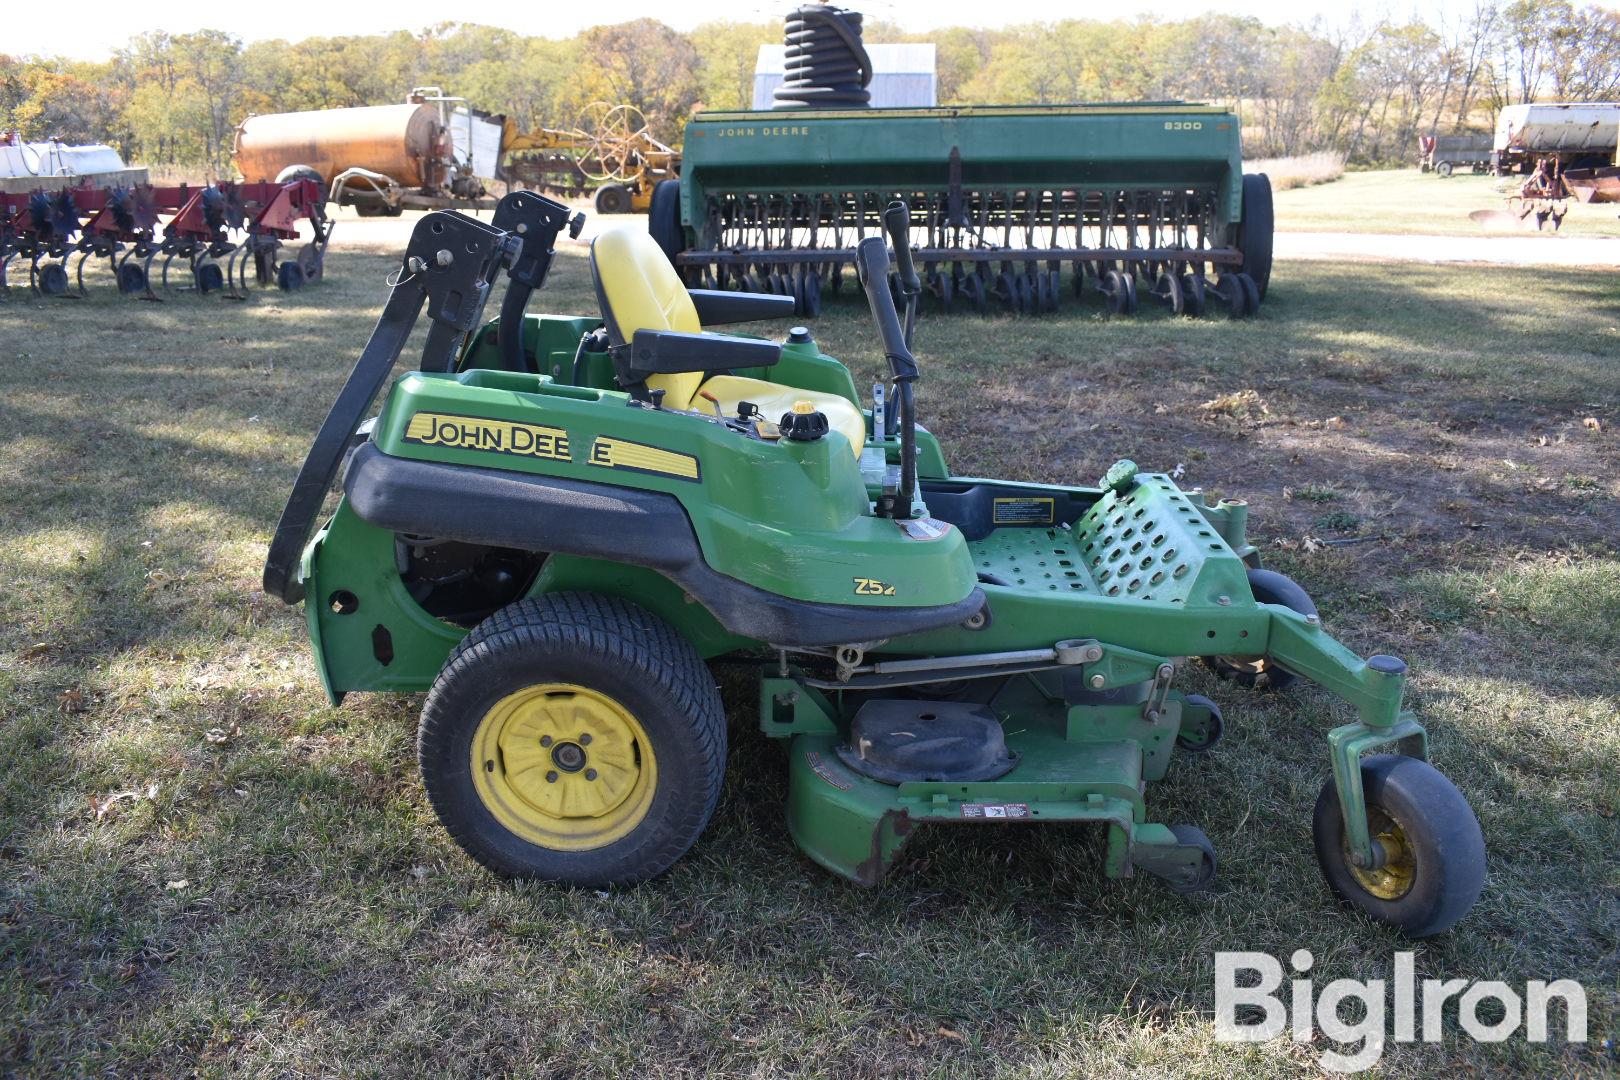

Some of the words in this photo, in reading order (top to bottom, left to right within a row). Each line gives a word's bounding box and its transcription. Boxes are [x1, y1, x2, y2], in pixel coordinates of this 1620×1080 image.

[1164, 121, 1202, 130] 8300
[719, 127, 755, 137] JOHN
[762, 126, 809, 136] DEERE
[421, 417, 501, 450] JOHN
[510, 426, 612, 464] DEEE
